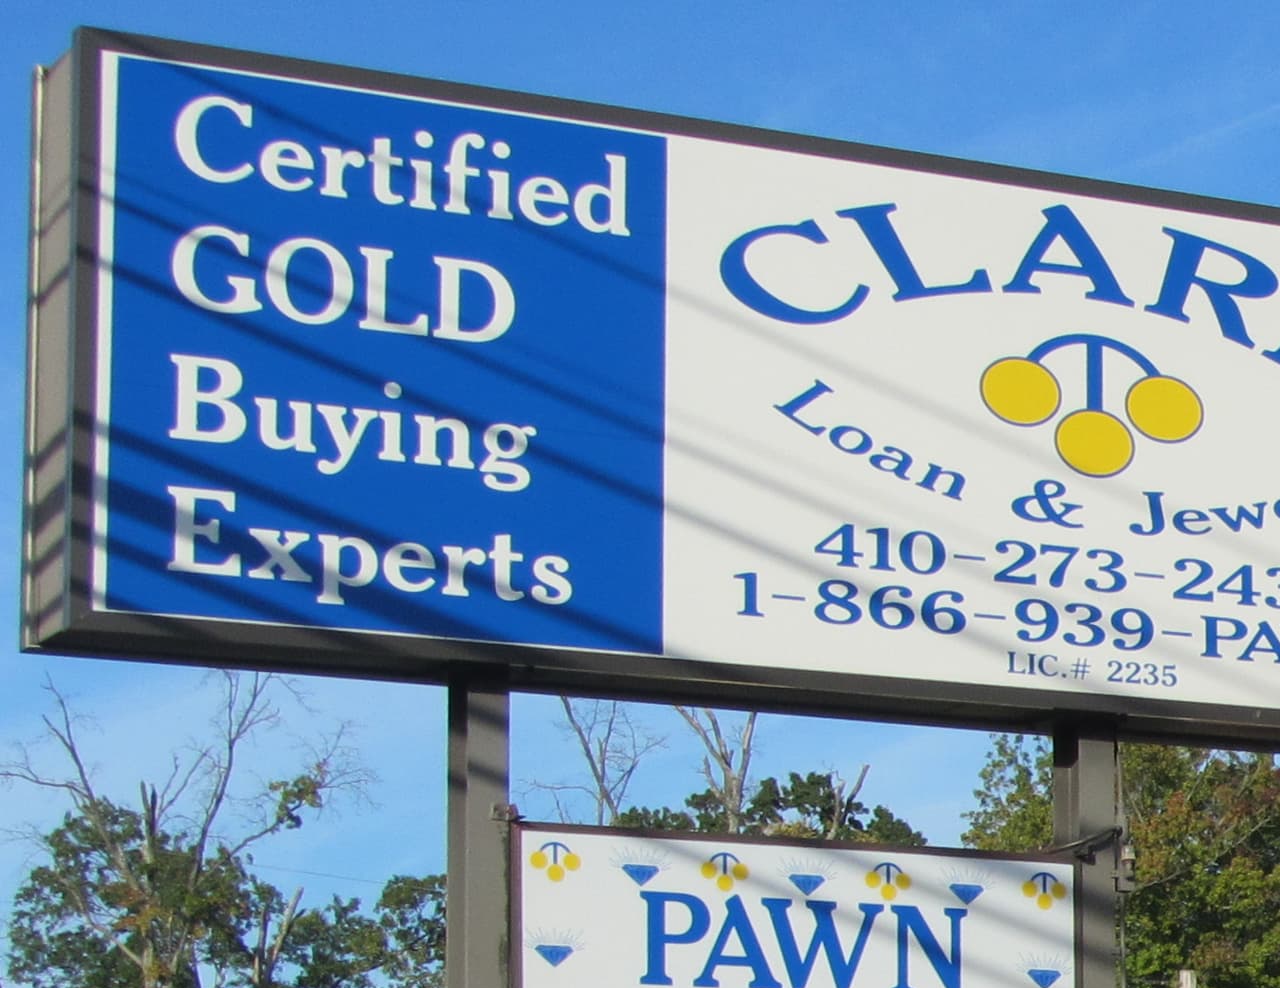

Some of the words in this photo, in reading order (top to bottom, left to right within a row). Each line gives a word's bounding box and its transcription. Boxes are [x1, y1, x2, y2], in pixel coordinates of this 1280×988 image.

[173, 94, 632, 237] Certified
[171, 224, 517, 343] GOLD
[168, 352, 537, 493] Buying
[773, 379, 967, 500] Loan
[1010, 479, 1084, 528] &
[166, 485, 573, 605] Experts
[1007, 651, 1091, 681] LIC.#
[1107, 660, 1178, 687] 2235
